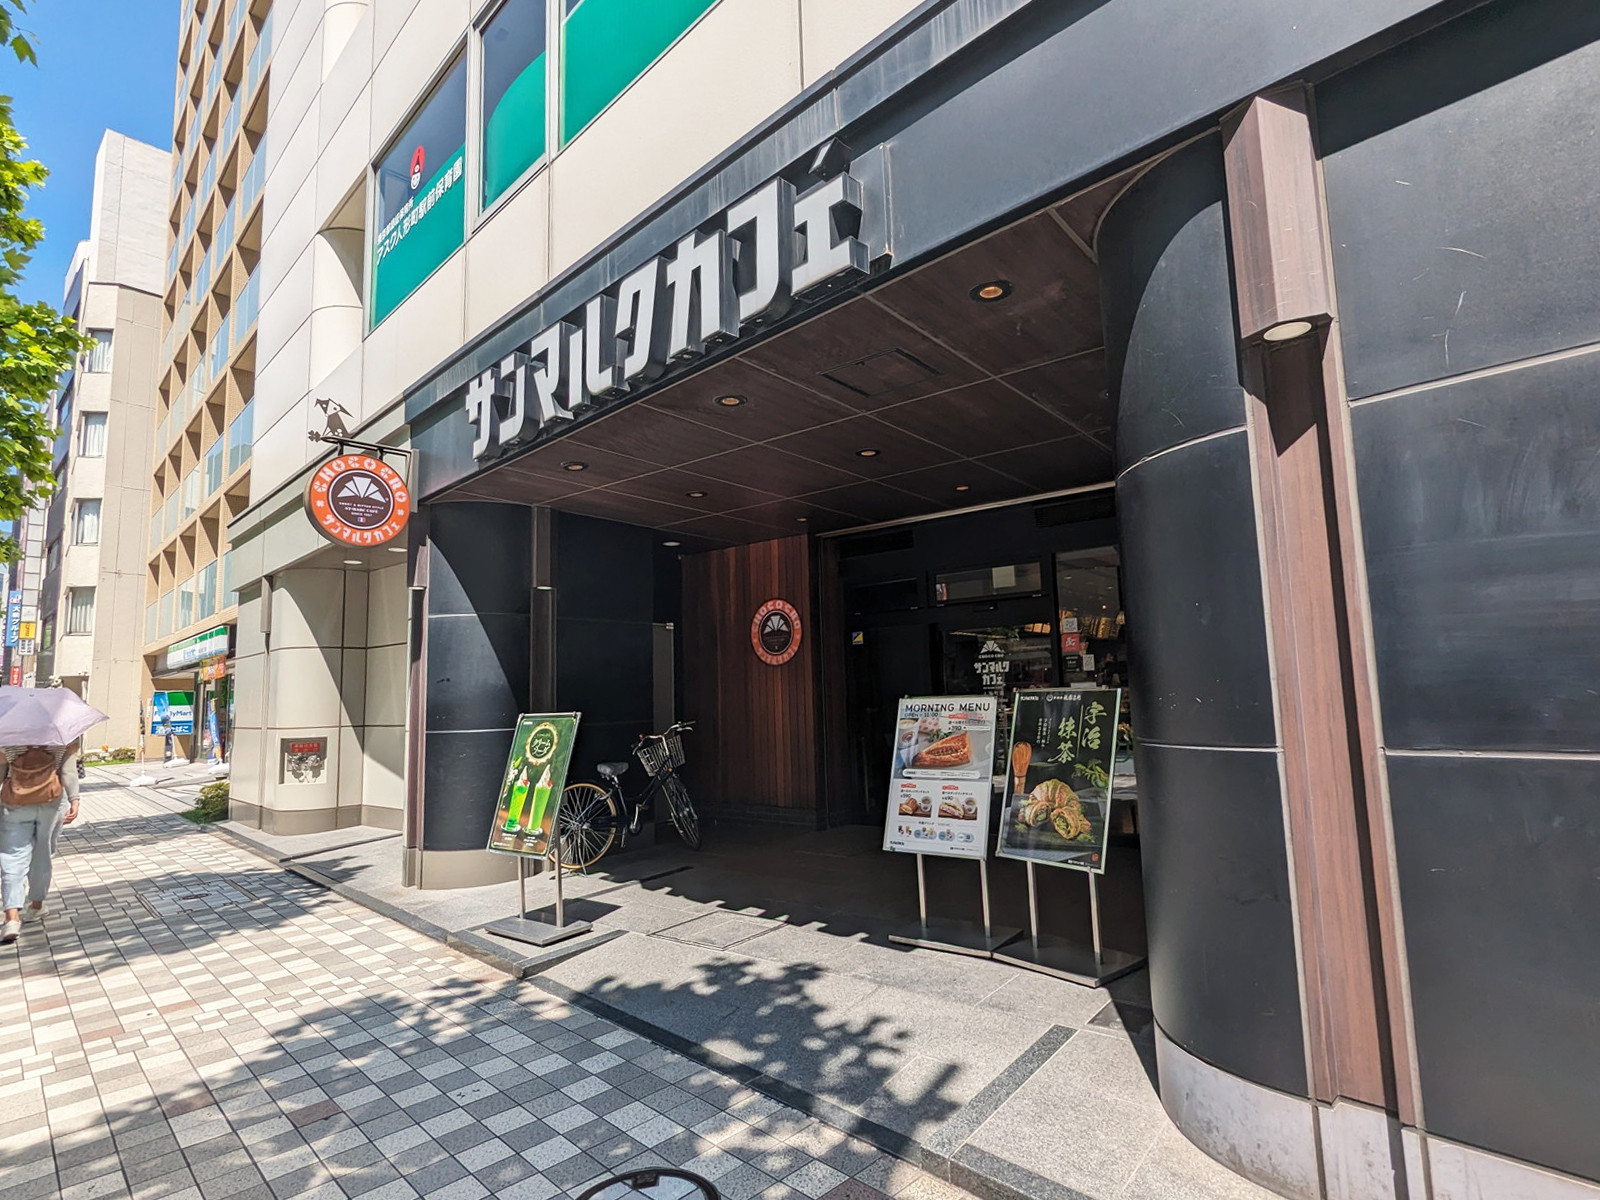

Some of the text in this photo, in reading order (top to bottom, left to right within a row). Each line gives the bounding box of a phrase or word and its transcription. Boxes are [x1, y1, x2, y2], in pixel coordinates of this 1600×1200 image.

[465, 138, 869, 461] サンマルクカフェ
[313, 456, 377, 493] CHOCO
[905, 702, 991, 713] MORNING MENU
[1081, 701, 1107, 750] 宇治
[1047, 716, 1078, 764] 抹茶
